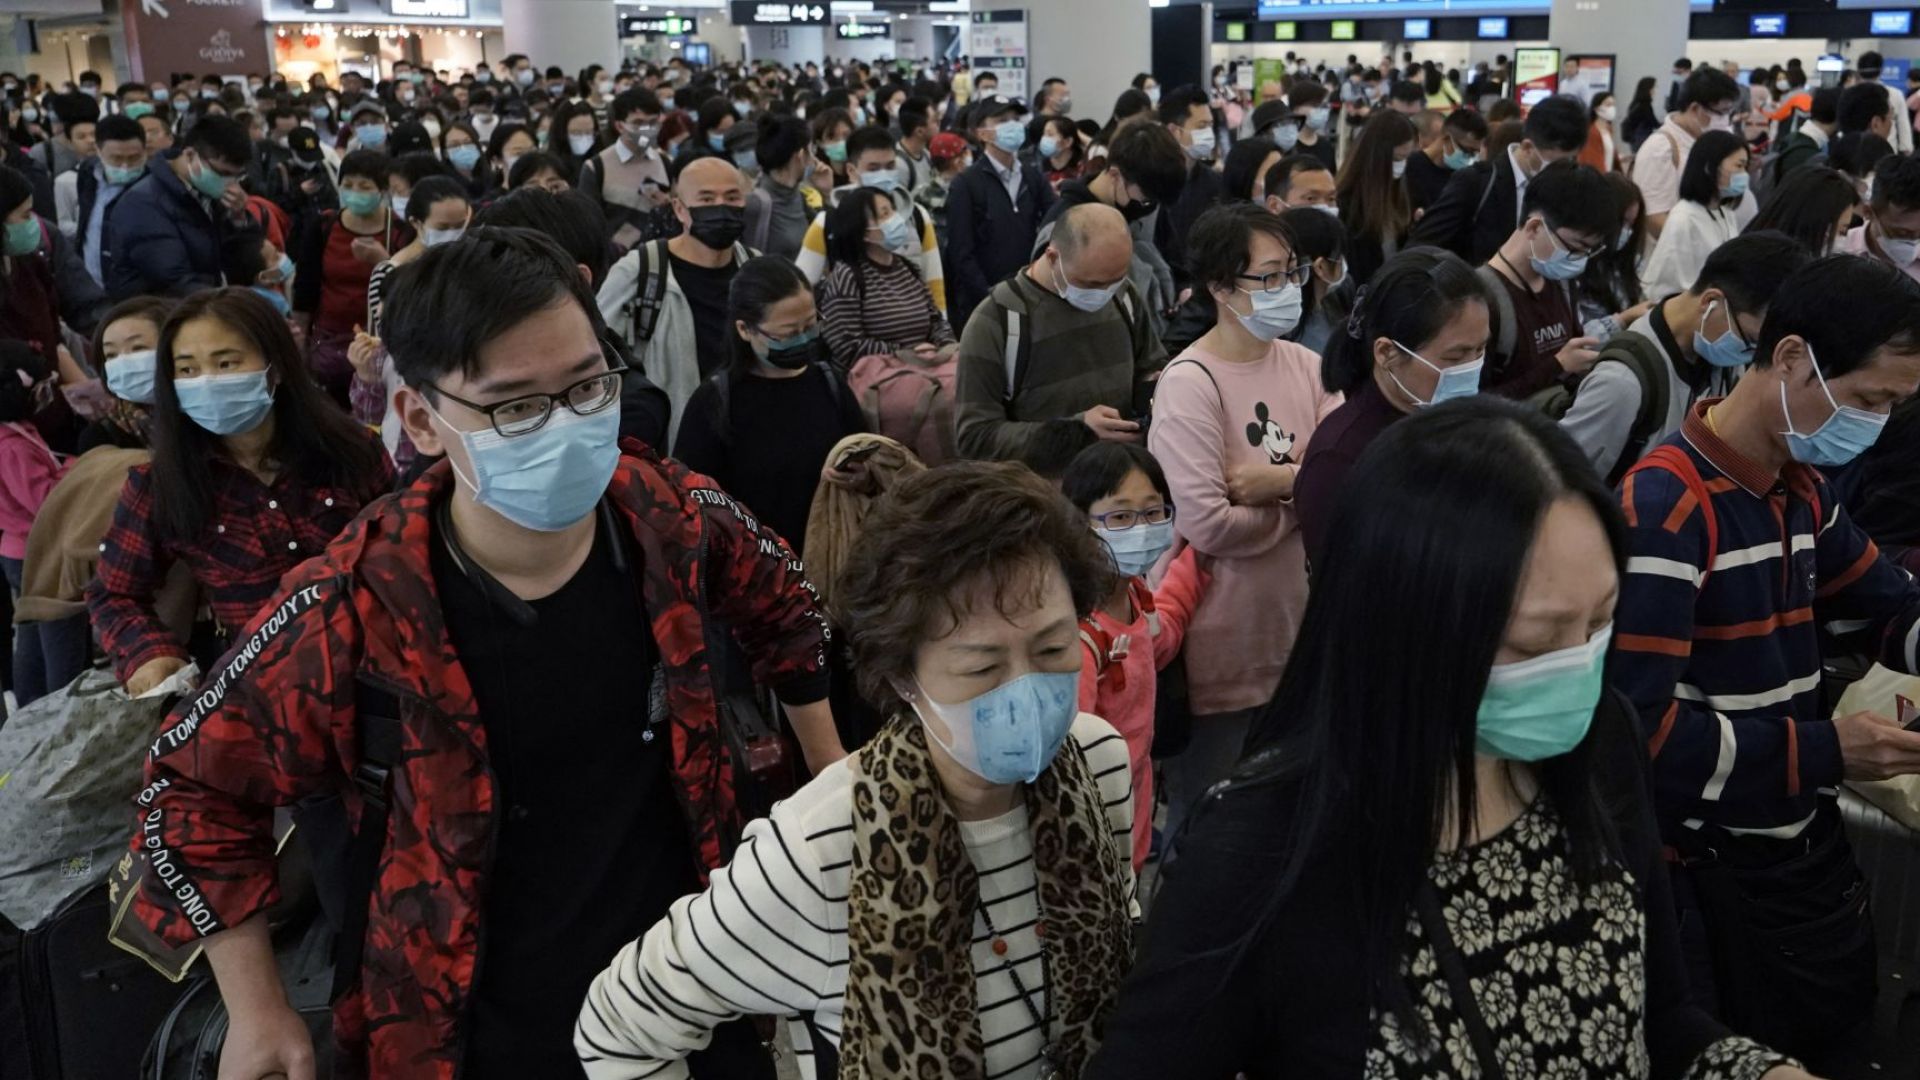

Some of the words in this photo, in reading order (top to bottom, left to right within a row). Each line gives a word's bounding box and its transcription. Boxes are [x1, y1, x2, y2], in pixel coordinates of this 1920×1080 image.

[259, 595, 298, 642] TOUY
[226, 635, 261, 679] TONG
[194, 669, 228, 715] TOUY
[175, 883, 217, 936] TONG
